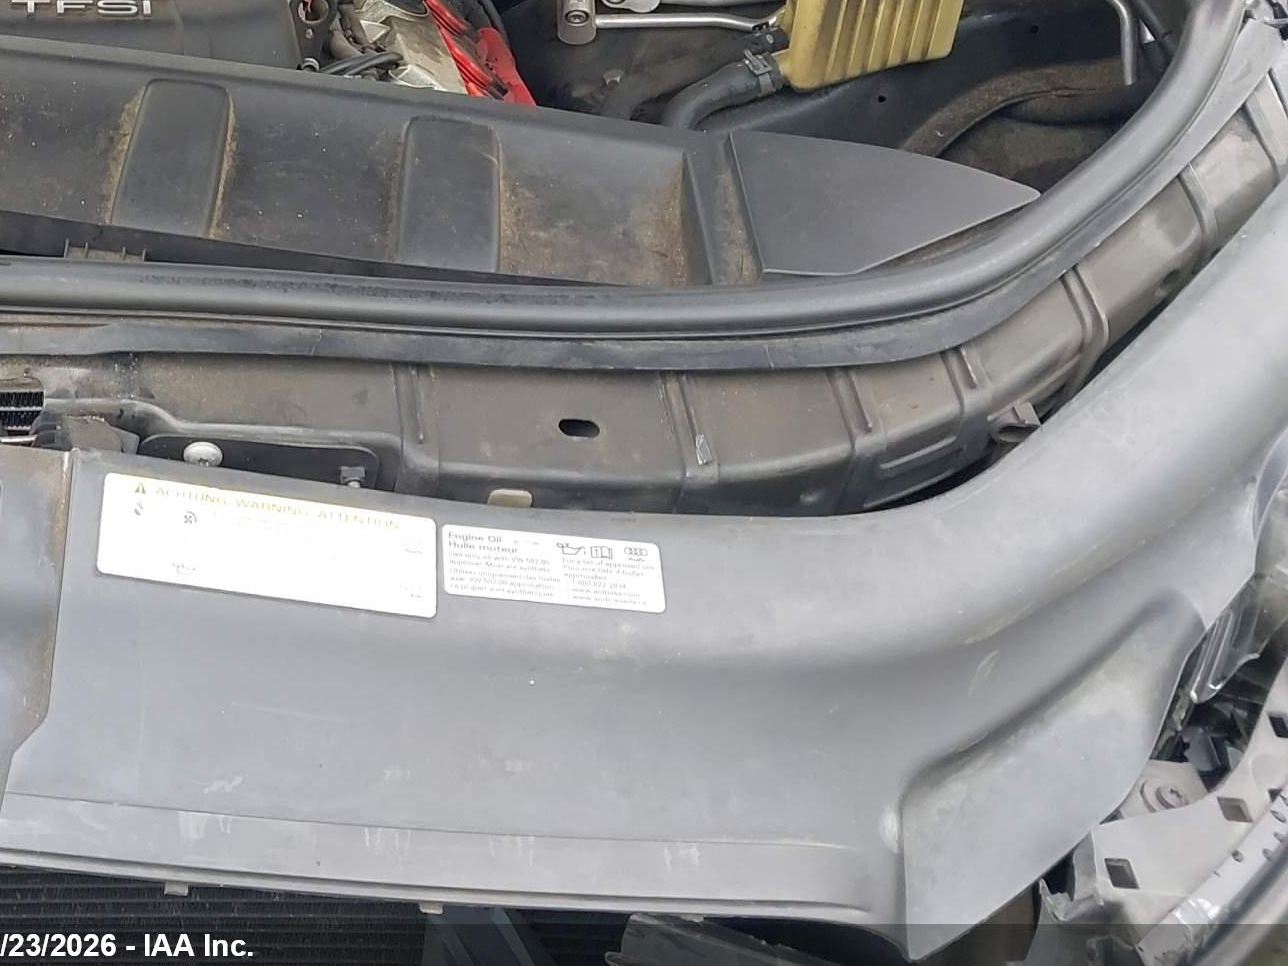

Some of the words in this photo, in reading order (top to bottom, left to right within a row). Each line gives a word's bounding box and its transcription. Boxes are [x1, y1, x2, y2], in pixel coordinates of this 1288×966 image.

[448, 531, 484, 542] Engine
[487, 535, 502, 543] Oil
[449, 540, 475, 550] Huile
[478, 545, 519, 553] moteur
